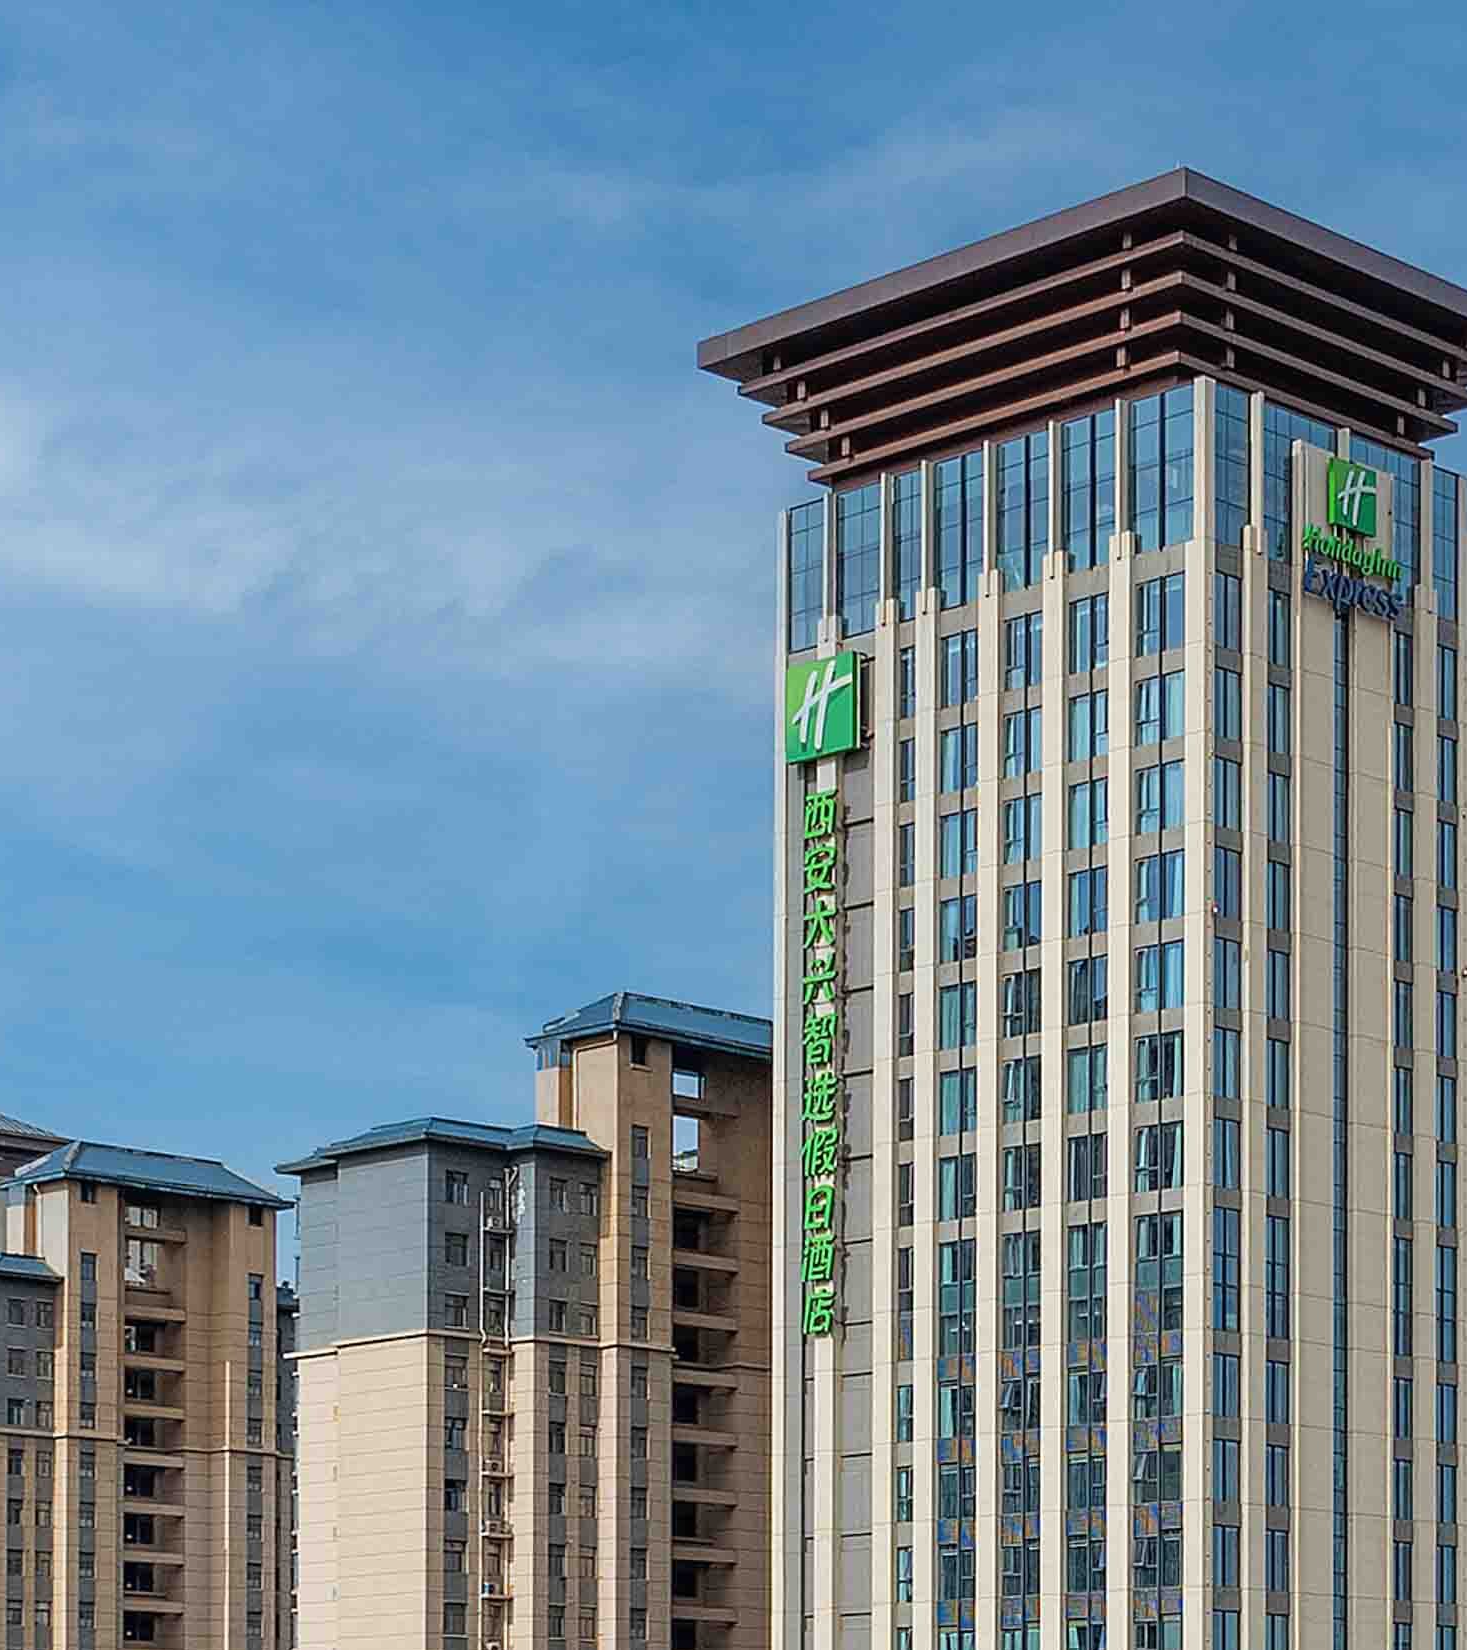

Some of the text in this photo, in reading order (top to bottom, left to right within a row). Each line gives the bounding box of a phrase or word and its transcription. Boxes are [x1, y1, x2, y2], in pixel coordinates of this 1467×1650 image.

[801, 788, 838, 1337] 西安大兴智选假日酒店
